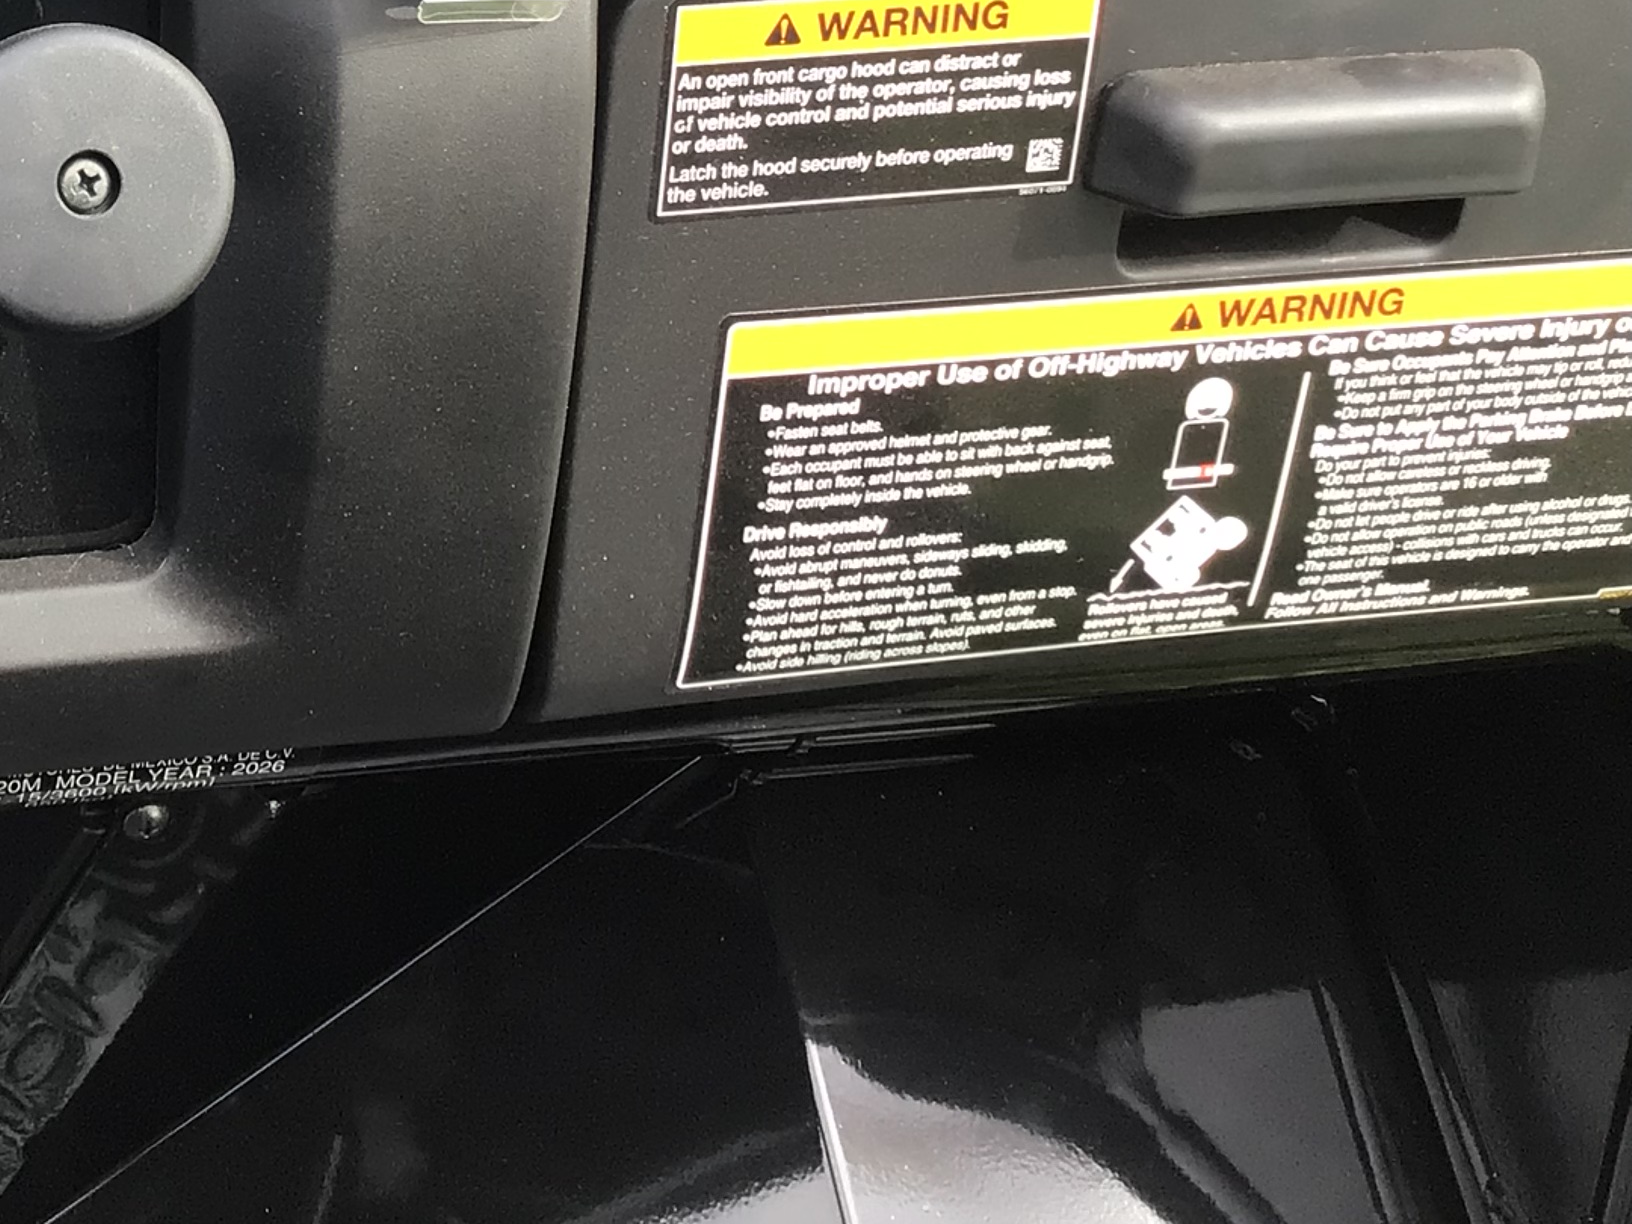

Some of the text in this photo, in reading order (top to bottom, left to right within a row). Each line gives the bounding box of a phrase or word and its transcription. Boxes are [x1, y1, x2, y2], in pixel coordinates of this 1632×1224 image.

[817, 0, 1010, 42] WARNING
[676, 68, 1072, 114] impair visibility of the operator, causing loss
[677, 51, 1023, 91] An open front cargo hood can distract or
[674, 88, 1076, 134] of vehicle control and potential serious injury
[669, 141, 1014, 183] Latch the hood securely before operating
[671, 133, 748, 155] or death.
[667, 181, 769, 204] the vehicle.
[1218, 287, 1405, 328] WARNING
[807, 369, 932, 398] Improper
[936, 363, 989, 386] Use
[994, 358, 1023, 381] of
[1028, 348, 1189, 378] Off-Highway
[1195, 338, 1303, 365] Vehicles
[1307, 334, 1359, 356] Can
[1364, 328, 1444, 352] Cause
[1448, 323, 1536, 345] Severe
[1539, 317, 1612, 342] Injury
[759, 397, 861, 423] Be Prepared
[55, 769, 140, 790] MODEL
[148, 765, 212, 782] YEAR
[231, 760, 286, 776] 2026
